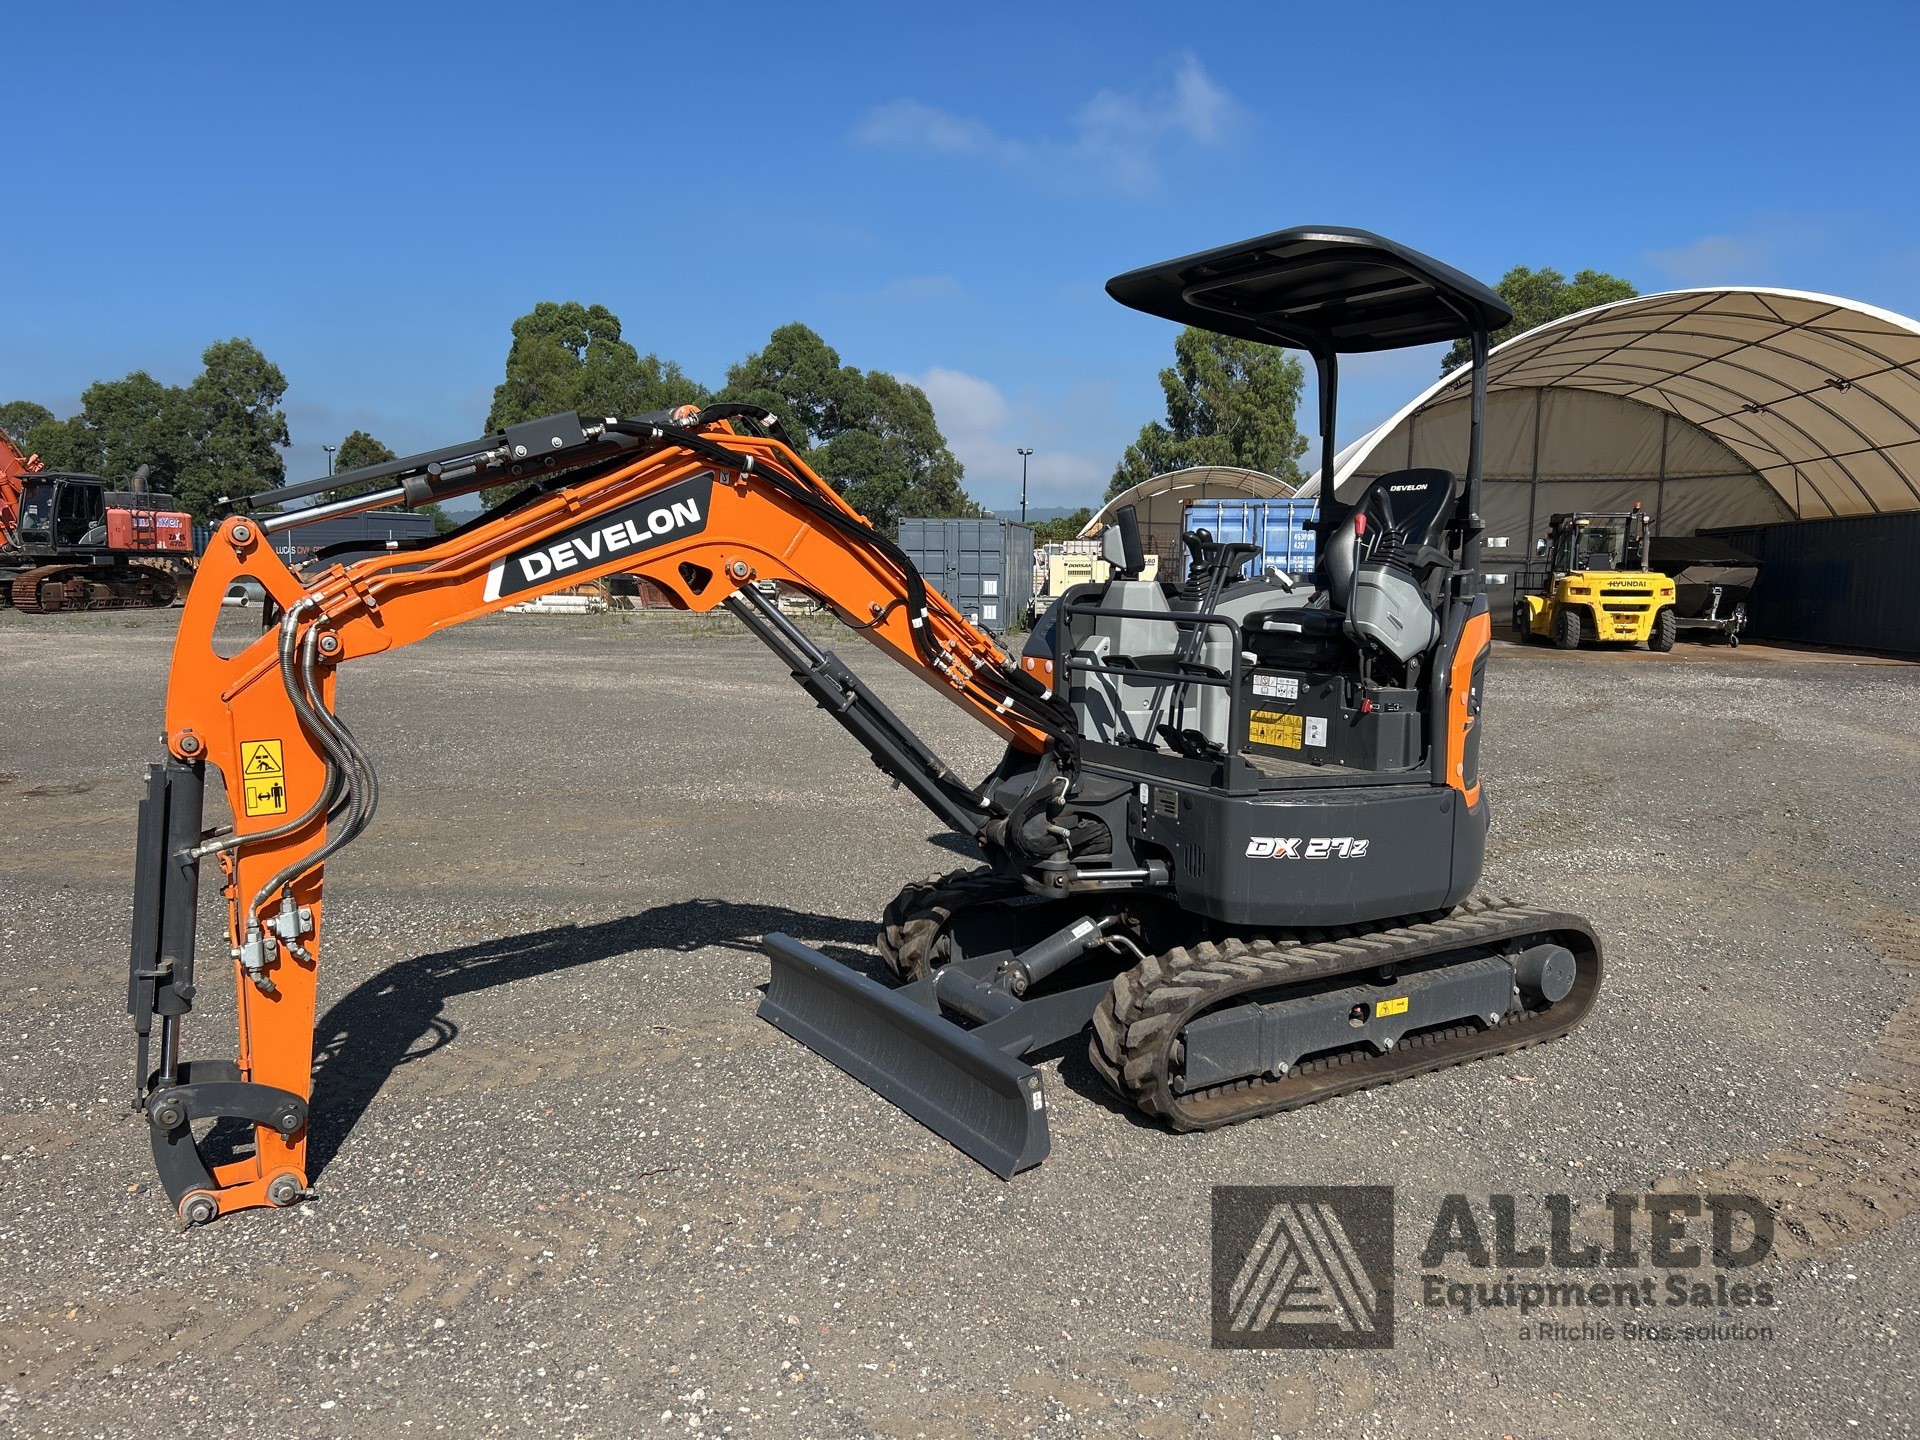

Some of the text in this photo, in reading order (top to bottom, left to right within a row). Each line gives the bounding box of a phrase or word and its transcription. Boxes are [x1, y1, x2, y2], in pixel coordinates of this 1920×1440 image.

[1390, 484, 1428, 492] DEVELON
[168, 532, 186, 541] ZAXIS
[519, 498, 701, 582] DEVELON
[1245, 836, 1303, 859] DX
